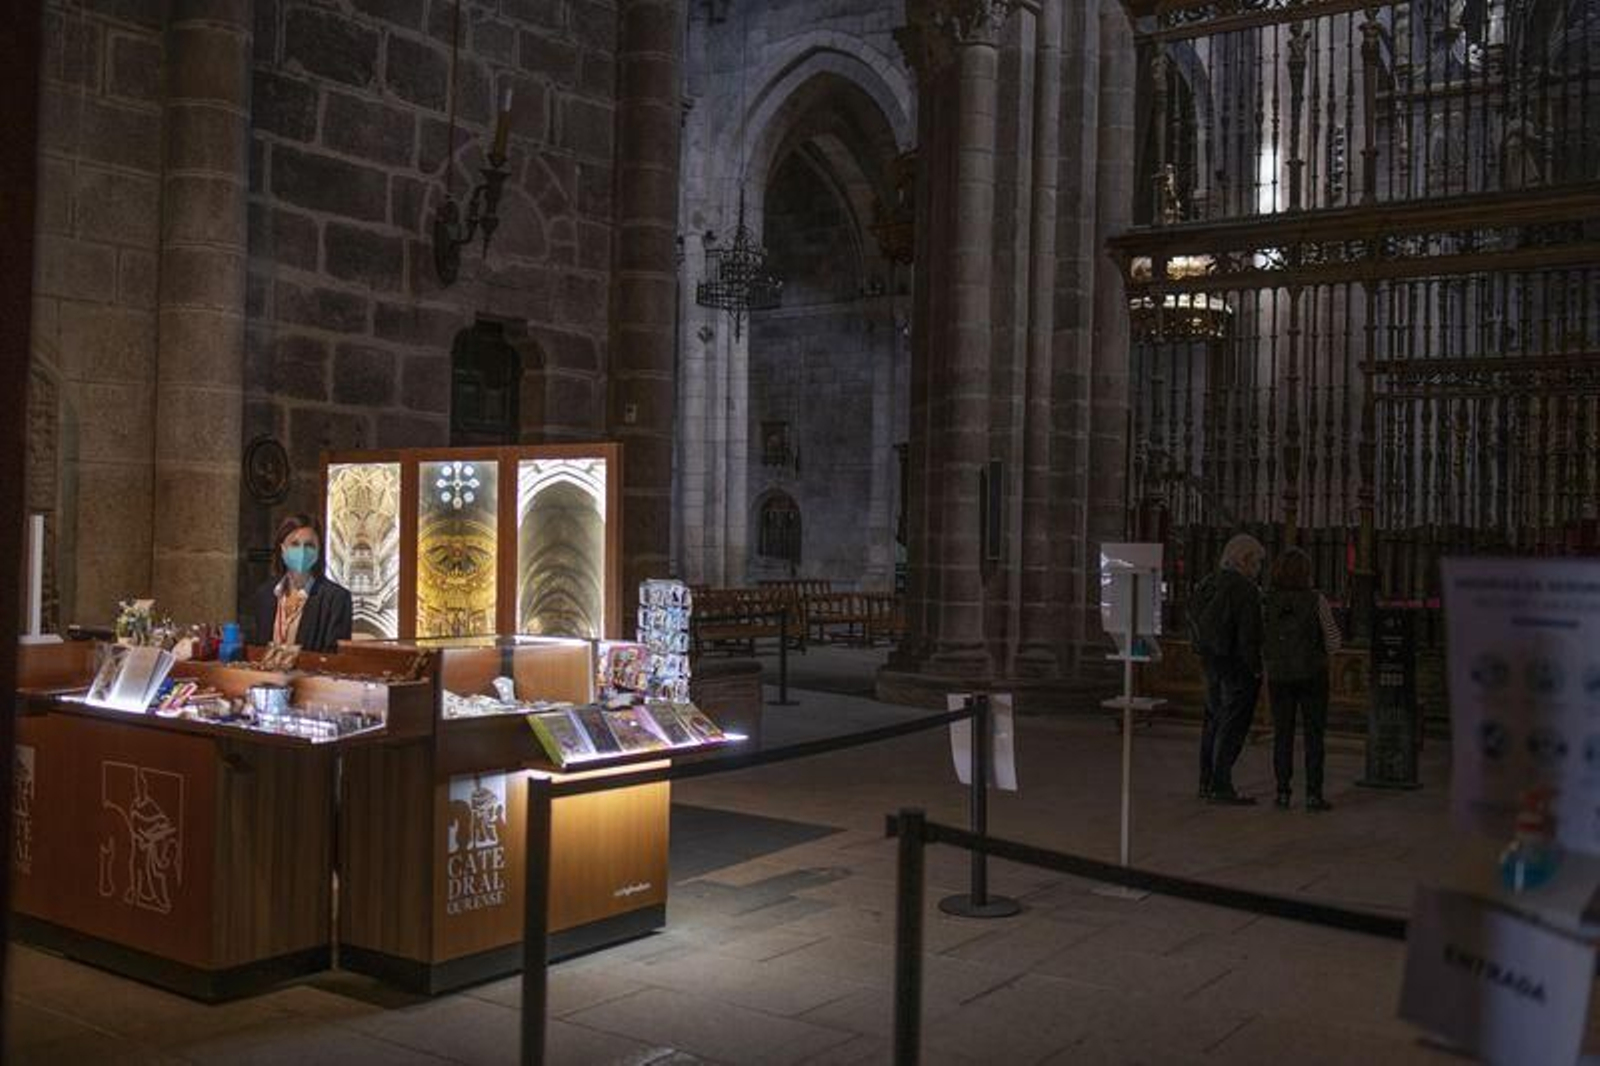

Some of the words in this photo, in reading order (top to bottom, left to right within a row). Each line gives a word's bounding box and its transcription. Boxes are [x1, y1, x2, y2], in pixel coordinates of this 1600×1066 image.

[447, 846, 505, 879] CATE
[448, 870, 505, 901] DRAL
[1443, 943, 1547, 1005] ENTRADA
